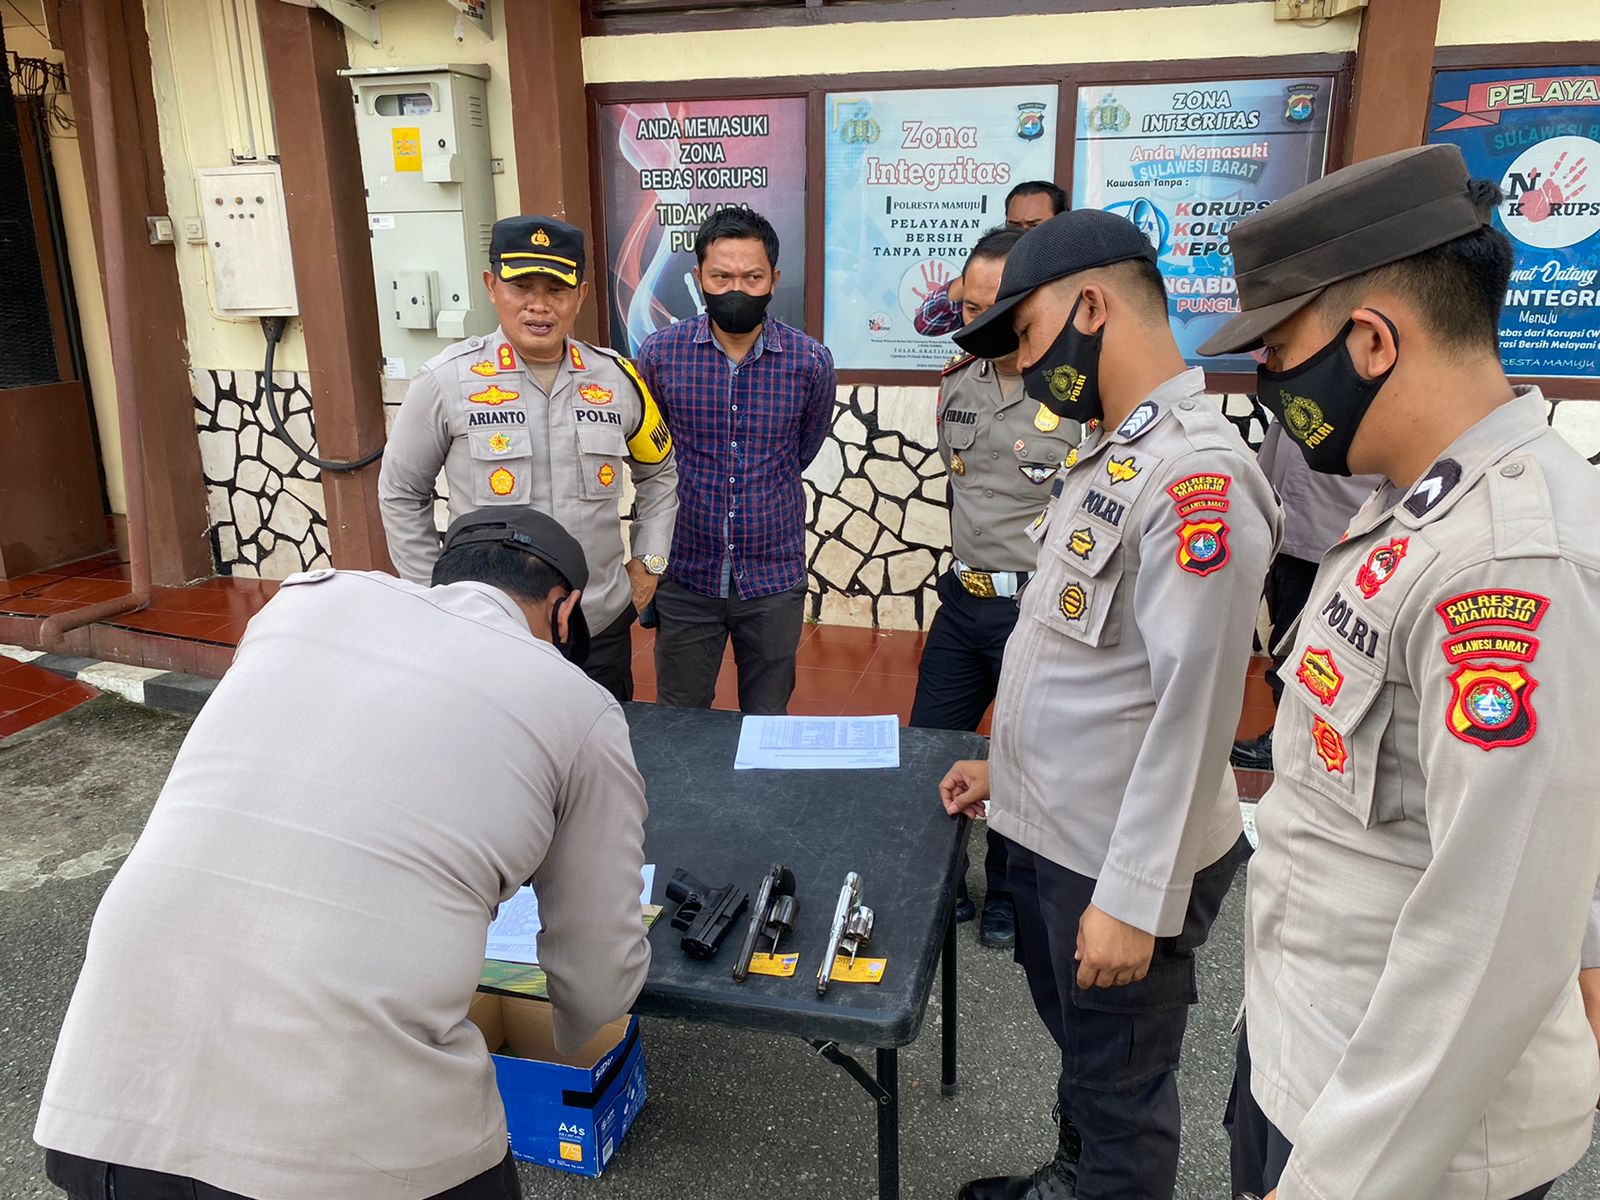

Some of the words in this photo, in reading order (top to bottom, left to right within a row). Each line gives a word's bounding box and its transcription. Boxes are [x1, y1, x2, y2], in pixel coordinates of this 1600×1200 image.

[1173, 90, 1231, 110] ZONA
[1488, 80, 1600, 108] PELAYA
[637, 117, 681, 139] ANDA
[684, 115, 769, 137] MEMASUKI
[1142, 110, 1260, 132] INTEGRITAS
[901, 120, 977, 149] Zona
[680, 143, 725, 163] ZONA
[1130, 144, 1176, 162] Anda
[1181, 141, 1269, 160] Memasuki
[641, 169, 693, 190] BEBAS
[696, 167, 768, 187] KORUPSI
[867, 156, 1010, 191] Integritas
[1139, 160, 1208, 180] SULAWESI
[1212, 160, 1258, 178] BARAT
[1106, 178, 1151, 188] Kawasan
[1154, 178, 1183, 188] Tanpa
[656, 203, 710, 225] TIDAK
[893, 202, 940, 210] POLRESTA
[941, 202, 980, 211] MAMUJU
[1175, 201, 1272, 217] KORUPS
[1507, 202, 1600, 217] KRUPS
[891, 219, 980, 229] PELAYANAN
[670, 230, 699, 253] PU
[906, 233, 963, 242] BERSIH
[873, 247, 921, 256] TANPA
[1163, 277, 1239, 295] NGABD
[1524, 328, 1545, 338] dari
[1546, 329, 1585, 339] Korupsi
[1518, 340, 1549, 348] Bersih
[1551, 340, 1596, 351] Melayani
[1070, 374, 1087, 402] POLRI
[468, 411, 526, 427] ARIANTO
[576, 410, 622, 426] POLRI
[945, 409, 977, 425] FIRDAUS
[1305, 422, 1335, 449] POLRI
[1172, 476, 1225, 493] POLRESTA
[1177, 483, 1223, 497] MAMUJU
[1081, 488, 1125, 526] POLRI
[1446, 595, 1536, 618] POLRESTA
[1322, 591, 1379, 659] POLRI
[1455, 607, 1531, 626] MAMUJU
[1450, 639, 1492, 656] SULAWESI
[1496, 639, 1529, 654] BARAT
